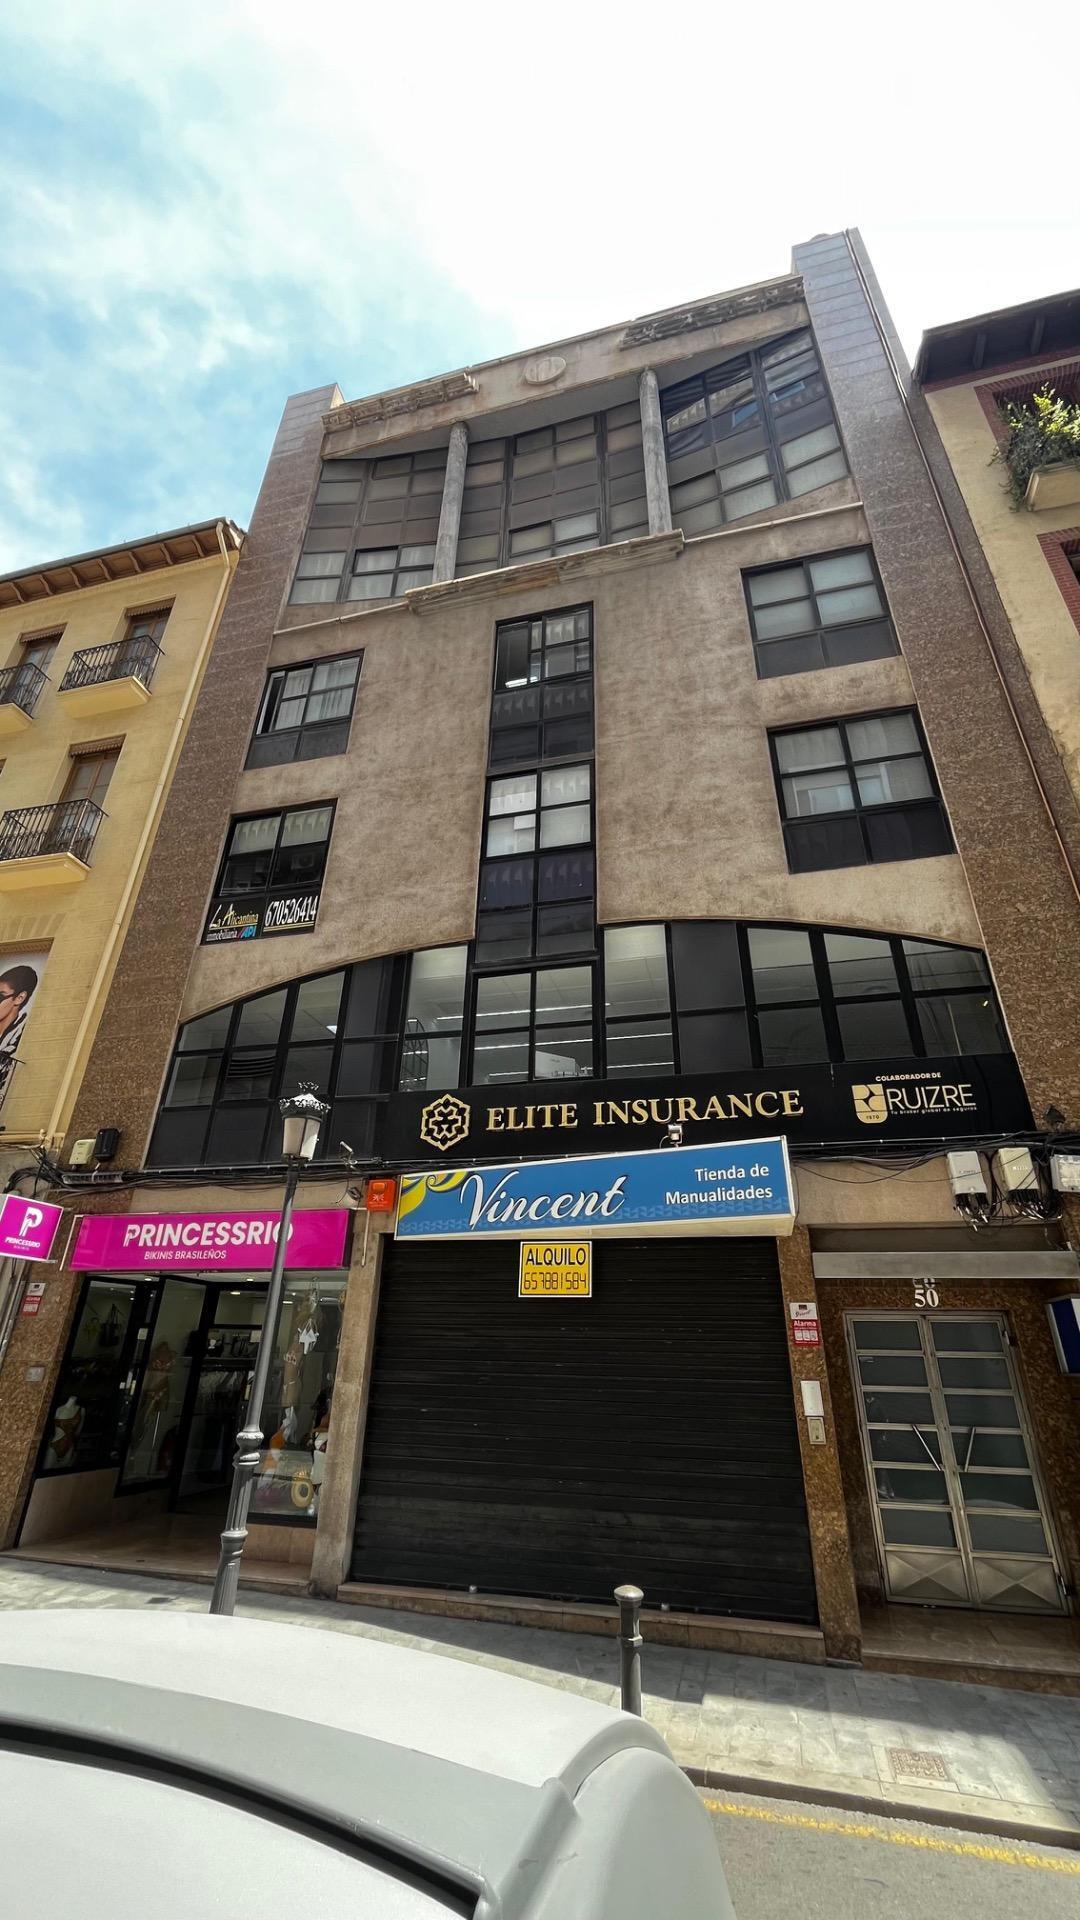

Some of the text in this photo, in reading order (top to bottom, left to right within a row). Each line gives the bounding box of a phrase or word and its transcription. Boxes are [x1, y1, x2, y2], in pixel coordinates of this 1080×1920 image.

[209, 903, 259, 929] La Alicantina
[265, 896, 318, 927] 670526414
[875, 1073, 930, 1081] COLABORADOR
[886, 1084, 976, 1110] RUIZRE
[486, 1089, 804, 1131] ELITE INSURANCE
[694, 1163, 770, 1183] Tienda de
[460, 1169, 629, 1231] Vincent
[666, 1184, 773, 1205] Manualidades
[123, 1220, 294, 1248] PRINCESSRIO
[144, 1248, 227, 1260] BIKINIS BRASILEÑOS
[525, 1247, 587, 1266] ALQUILO
[523, 1271, 587, 1290] 657881584
[914, 1288, 939, 1307] 50
